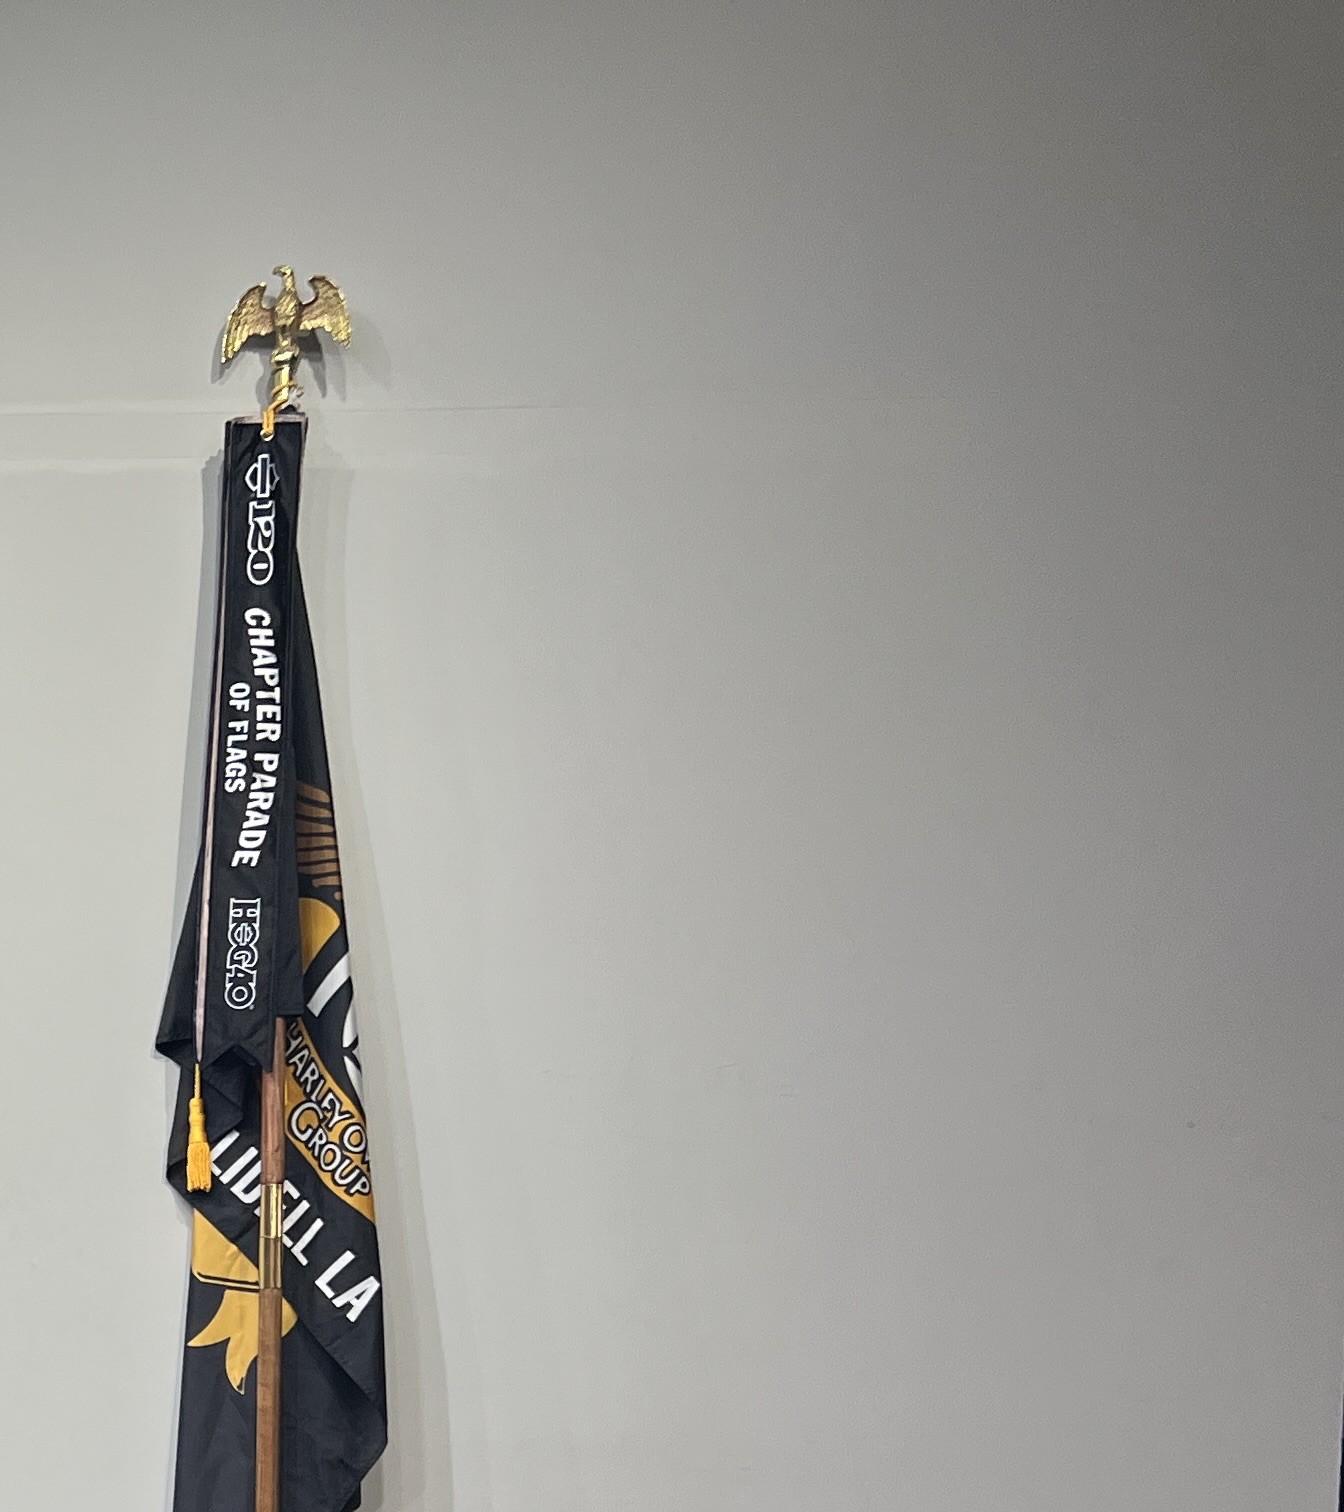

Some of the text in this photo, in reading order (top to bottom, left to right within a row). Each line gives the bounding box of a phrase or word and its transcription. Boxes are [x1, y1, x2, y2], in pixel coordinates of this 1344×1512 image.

[224, 681, 251, 794] OF FLAGS
[230, 607, 283, 867] CHAPTER PARADE
[290, 1101, 371, 1195] GROUP
[315, 1250, 381, 1323] LA
